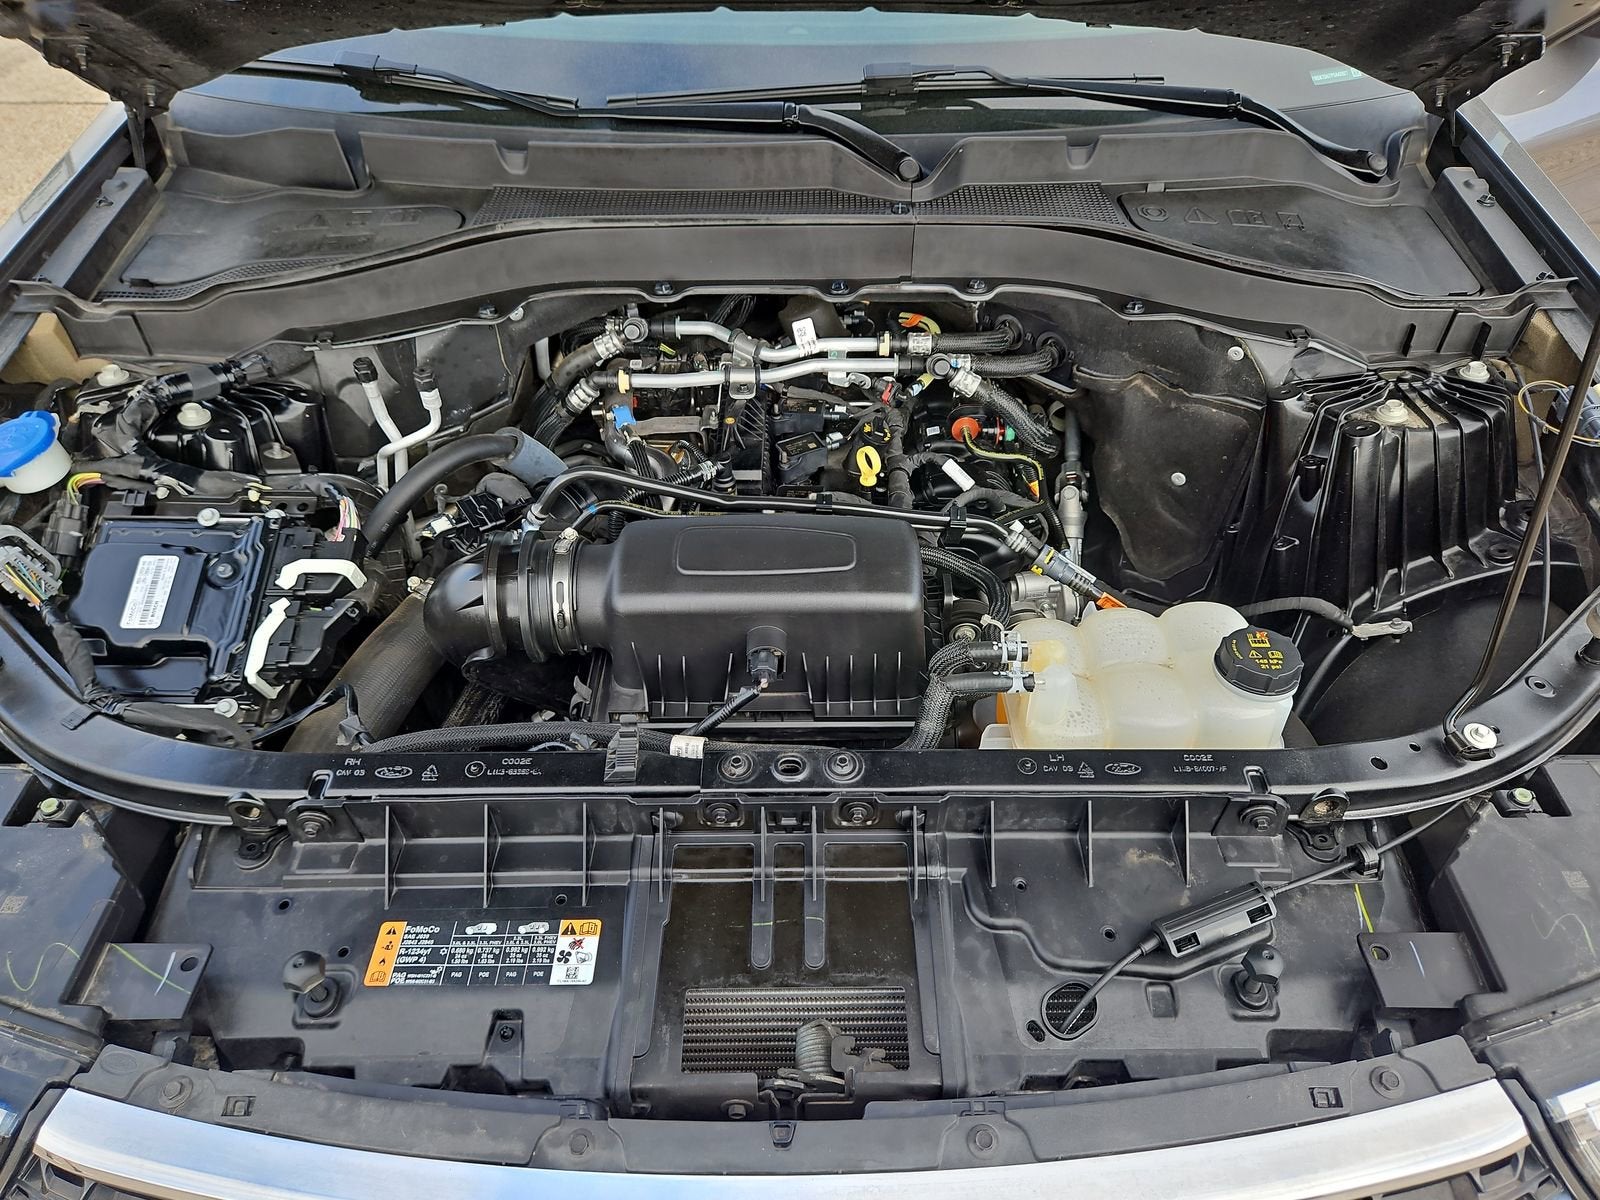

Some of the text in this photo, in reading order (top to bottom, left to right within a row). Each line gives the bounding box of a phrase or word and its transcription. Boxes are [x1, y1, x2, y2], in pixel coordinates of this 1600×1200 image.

[345, 758, 361, 766] RH
[1049, 754, 1065, 762] LH
[405, 926, 440, 934] FoMoCo
[399, 948, 432, 956] R-1234yf
